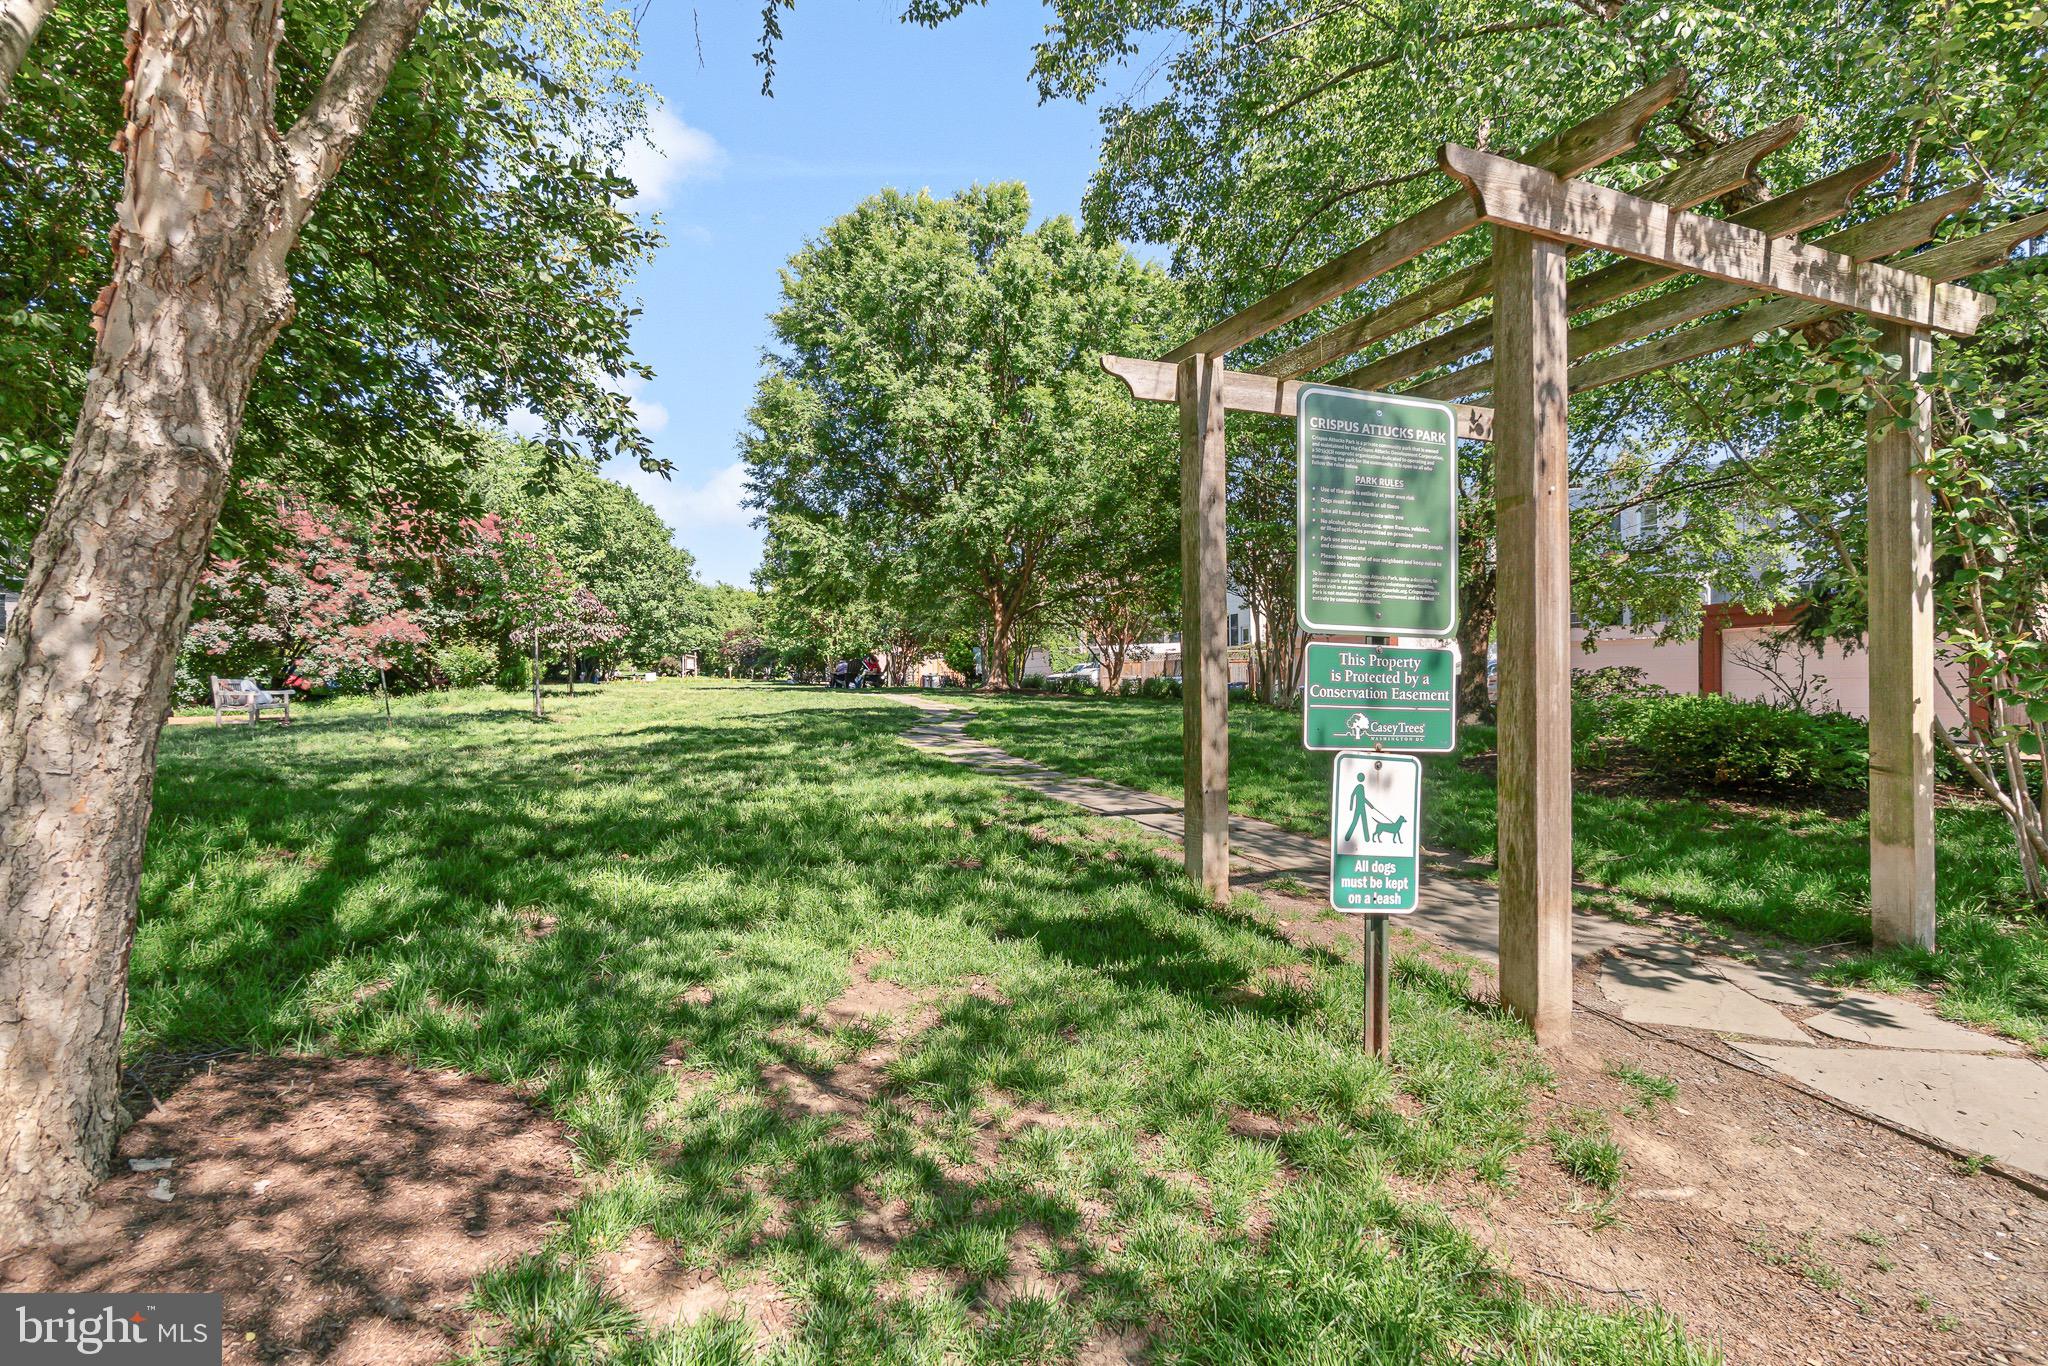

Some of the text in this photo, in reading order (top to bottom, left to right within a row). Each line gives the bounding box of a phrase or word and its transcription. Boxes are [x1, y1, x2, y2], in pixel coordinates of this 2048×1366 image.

[1310, 416, 1446, 443] CRISPUS ATTUCKS PARK
[1356, 476, 1404, 488] PARK RULES
[1338, 653, 1421, 672] This Property
[1331, 670, 1429, 688] is Protected by a
[1310, 684, 1450, 701] Conservation Easement
[1370, 721, 1398, 735] Casey
[1354, 860, 1397, 876] All dogs
[1341, 876, 1408, 891] must be kept
[1348, 892, 1402, 905] on a leash
